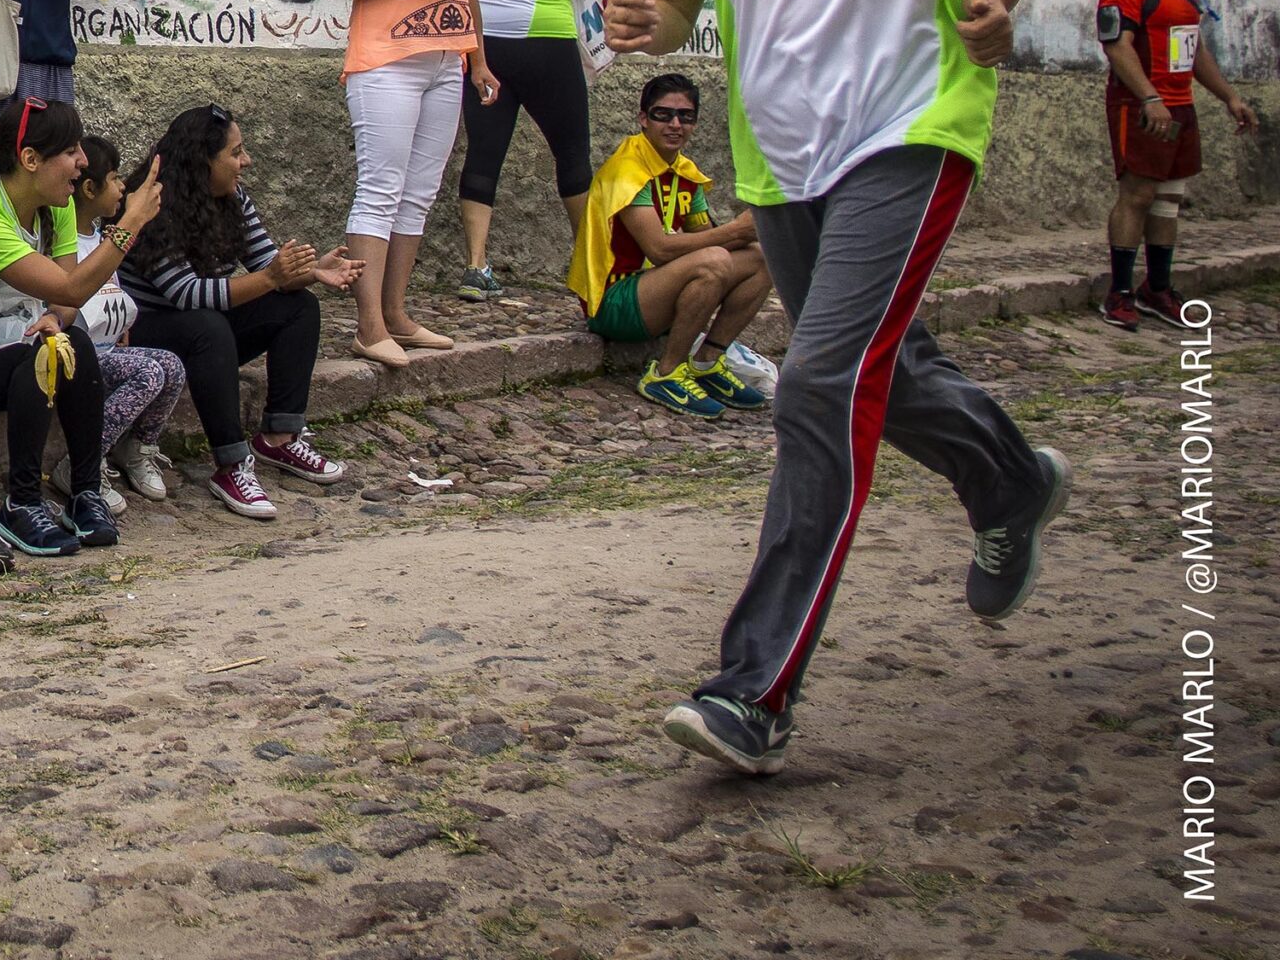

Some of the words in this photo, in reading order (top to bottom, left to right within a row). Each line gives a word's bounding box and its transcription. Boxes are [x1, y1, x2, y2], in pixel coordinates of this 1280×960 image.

[71, 2, 256, 45] RGANIZACIÓN
[677, 191, 692, 215] R
[102, 296, 127, 337] 111
